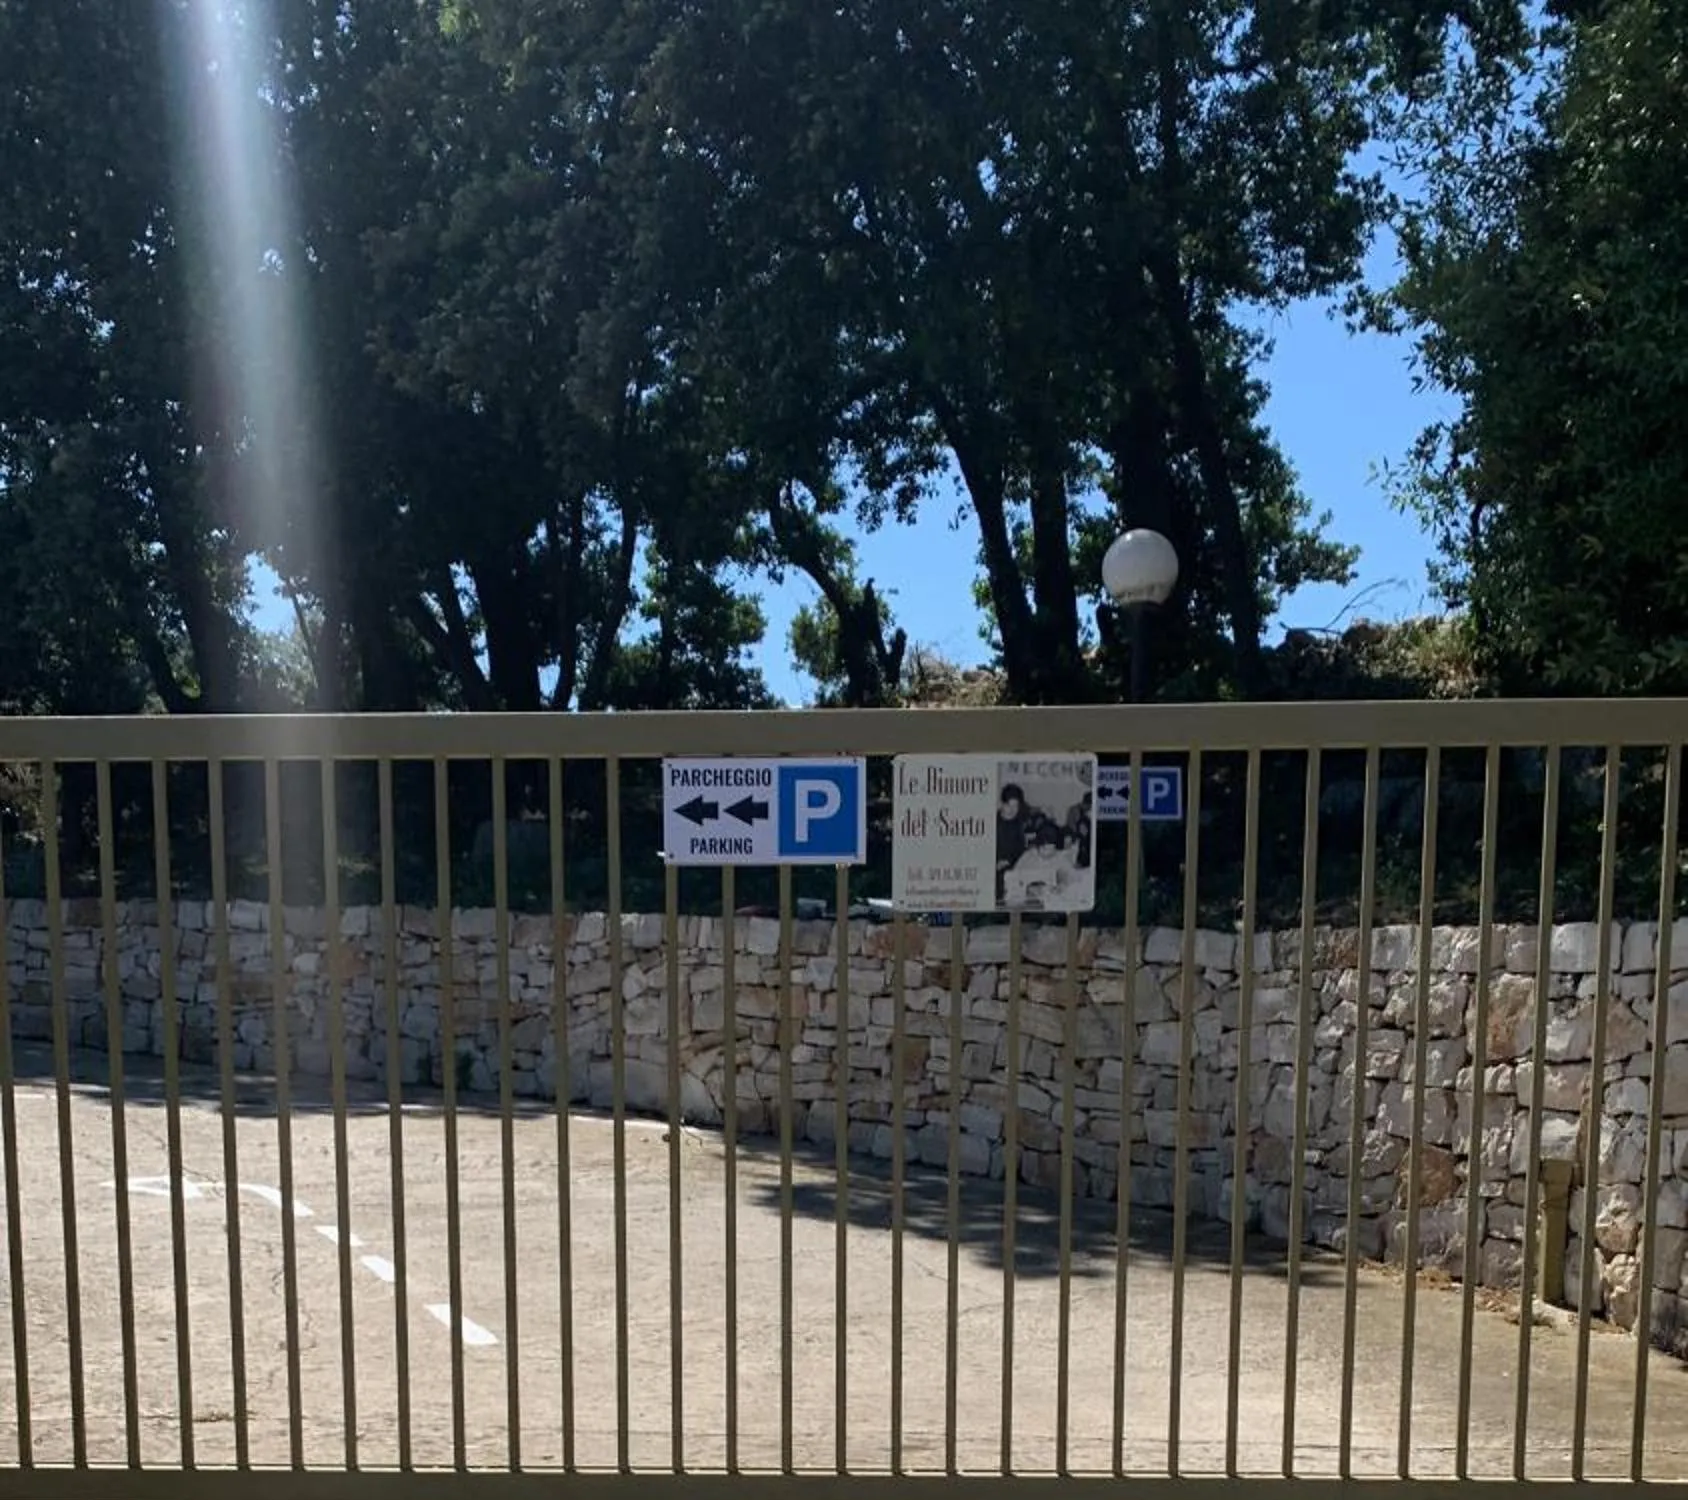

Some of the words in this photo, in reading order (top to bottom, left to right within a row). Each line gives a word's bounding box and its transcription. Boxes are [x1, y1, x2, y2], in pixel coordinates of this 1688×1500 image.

[670, 768, 772, 787] PARCHEGGIO
[899, 762, 919, 795] Le
[927, 765, 989, 795] Dimore
[1147, 777, 1170, 810] P
[794, 779, 841, 843] P
[901, 807, 927, 837] del
[937, 807, 985, 837] Sarto
[690, 836, 753, 855] PARKING
